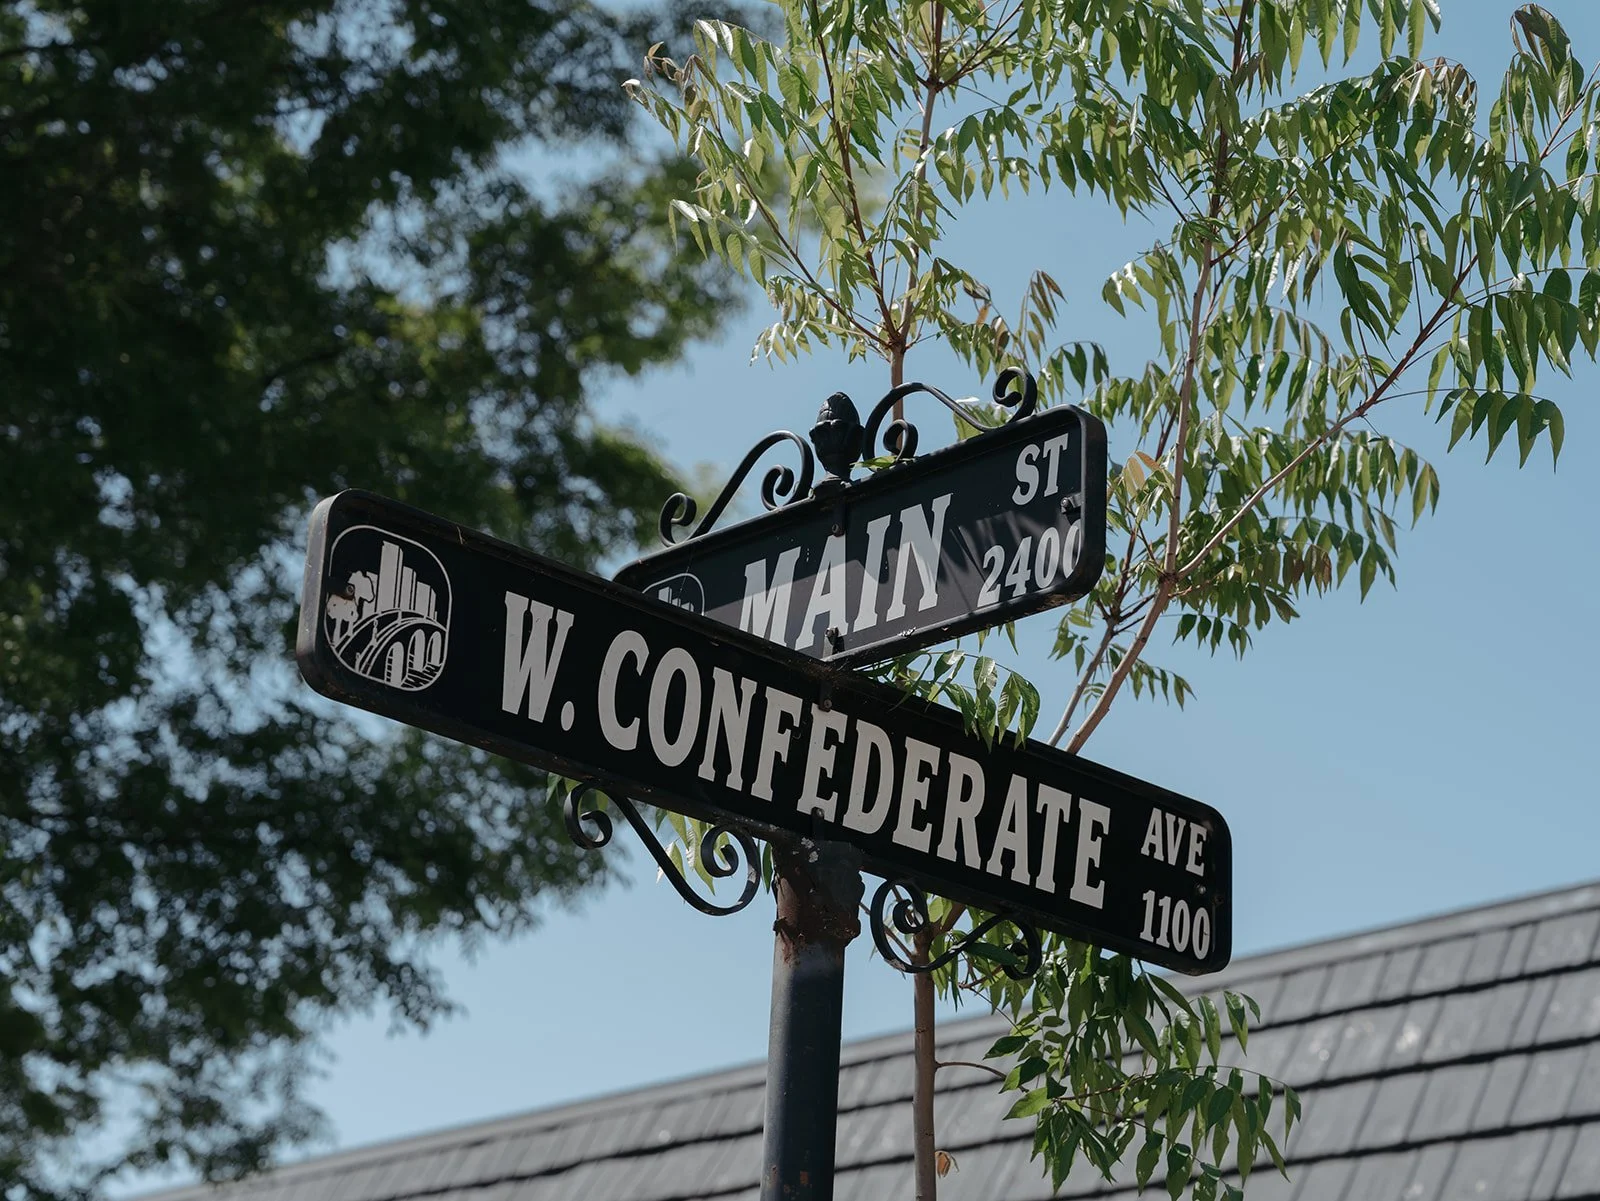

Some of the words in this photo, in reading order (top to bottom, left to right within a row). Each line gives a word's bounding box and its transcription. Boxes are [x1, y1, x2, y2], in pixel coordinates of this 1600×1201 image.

[739, 493, 953, 650] MAIN
[1012, 433, 1069, 506] ST
[977, 519, 1082, 607] 2400
[502, 590, 575, 731] W.
[598, 630, 1110, 910] CONFEDERATE
[1141, 807, 1207, 877] AVE
[1140, 890, 1211, 960] 1100
